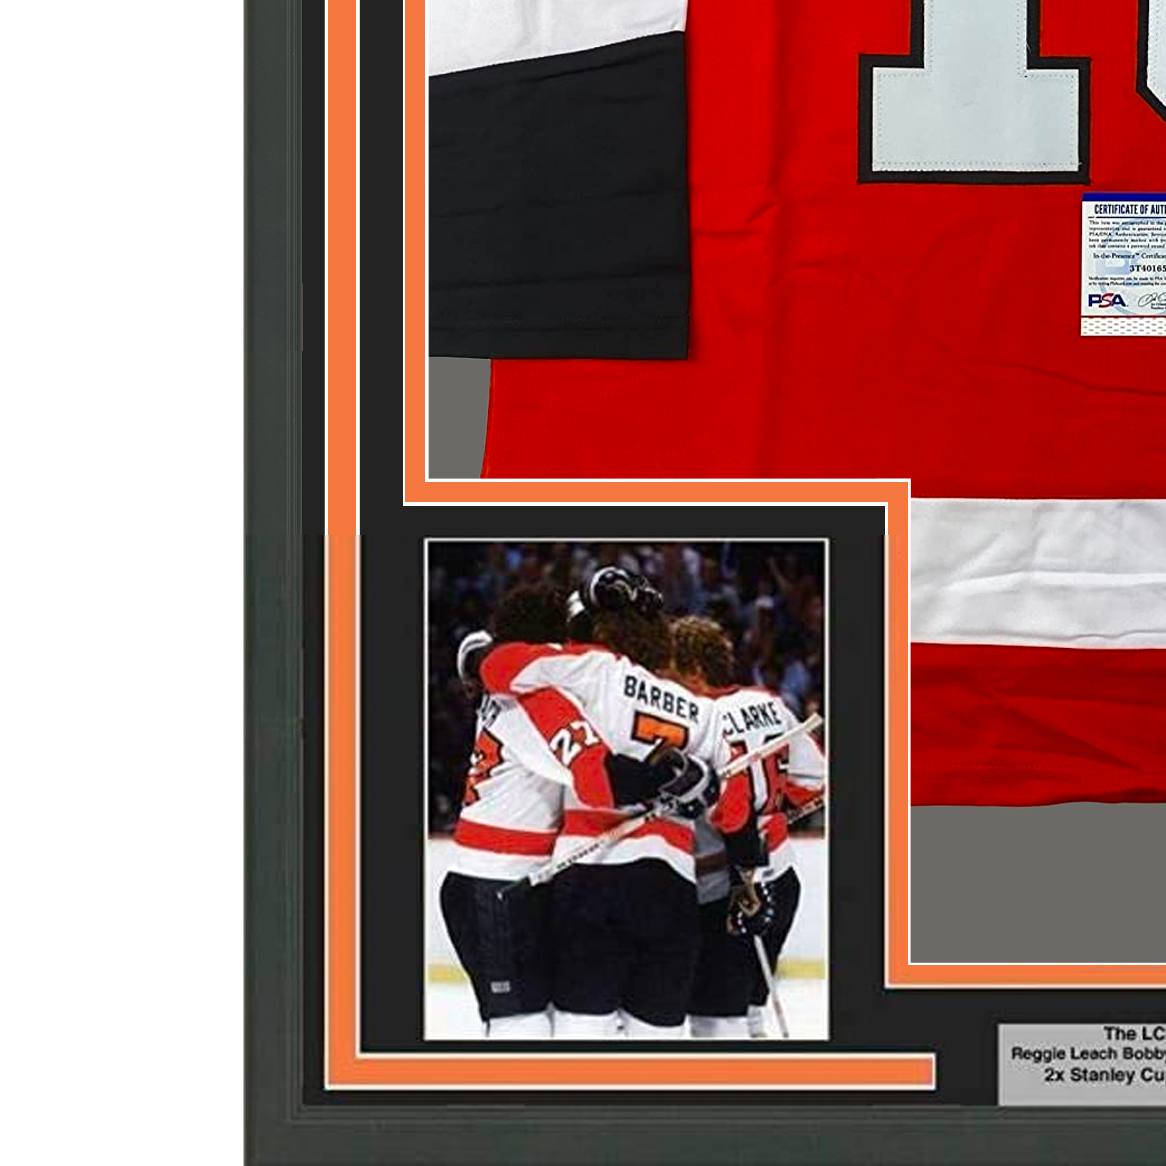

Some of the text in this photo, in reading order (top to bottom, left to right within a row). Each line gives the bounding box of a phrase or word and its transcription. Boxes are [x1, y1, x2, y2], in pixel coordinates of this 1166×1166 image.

[1094, 204, 1138, 215] CERTIFICATE
[1140, 204, 1148, 215] OF
[1088, 292, 1128, 308] PSA
[624, 675, 699, 724] BARBER
[722, 700, 782, 736] CLARKE
[549, 720, 601, 768] 27
[1103, 1026, 1137, 1041] The
[1011, 1046, 1066, 1063] Reggie
[1070, 1046, 1118, 1060] Leach
[1044, 1067, 1065, 1082] 2x
[1070, 1067, 1134, 1086] Stanley
